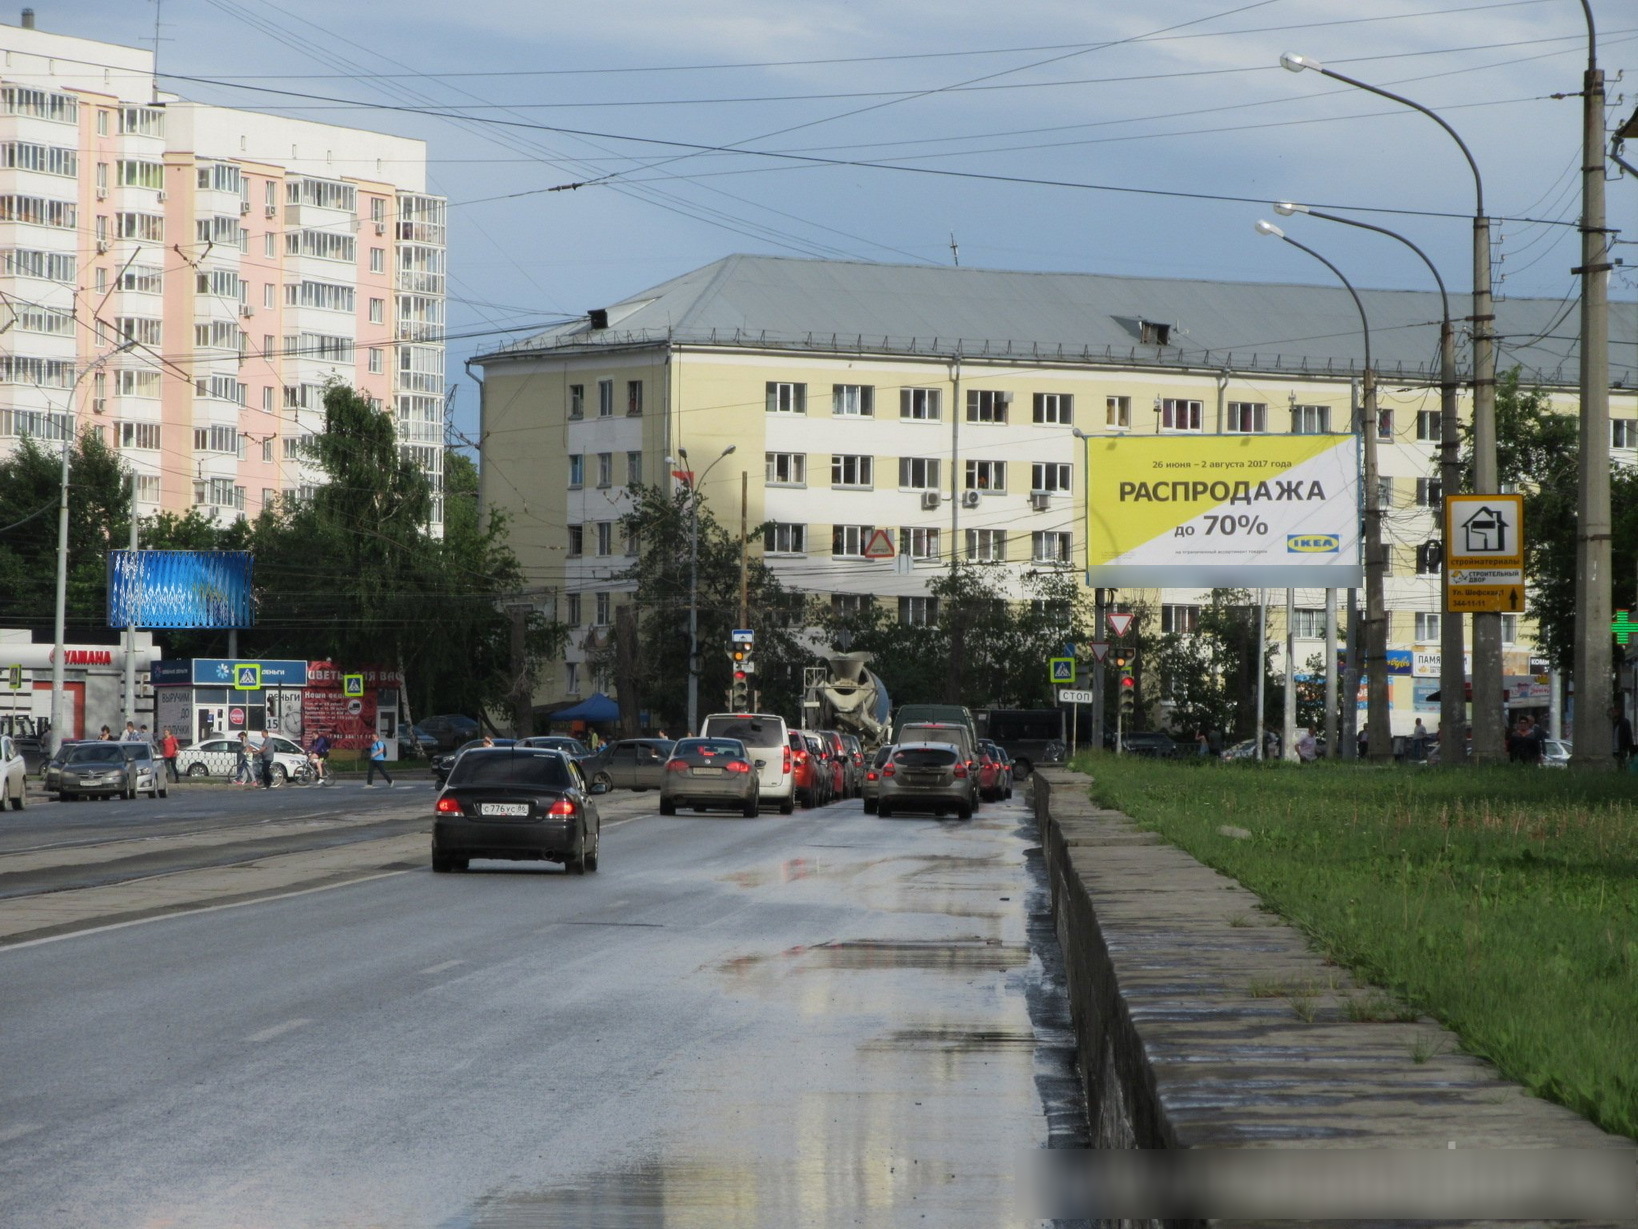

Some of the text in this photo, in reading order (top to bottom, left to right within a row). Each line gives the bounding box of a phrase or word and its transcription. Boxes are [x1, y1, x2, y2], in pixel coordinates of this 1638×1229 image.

[1152, 460, 1164, 469] 26
[1201, 460, 1207, 468] 2
[1209, 462, 1245, 470] августа
[1247, 460, 1268, 468] 2017
[1270, 461, 1292, 469] года
[1119, 480, 1326, 505] РАСПРОДАЖА
[1174, 514, 1268, 538] до 70%
[1293, 539, 1334, 547] IKEA
[1451, 558, 1520, 566] стройматериалы
[65, 651, 112, 664] YAMAHA
[161, 692, 190, 703] ВЫРУЧИМ
[1062, 691, 1090, 701] СТОП
[180, 708, 190, 719] ДО
[266, 719, 279, 729] 15
